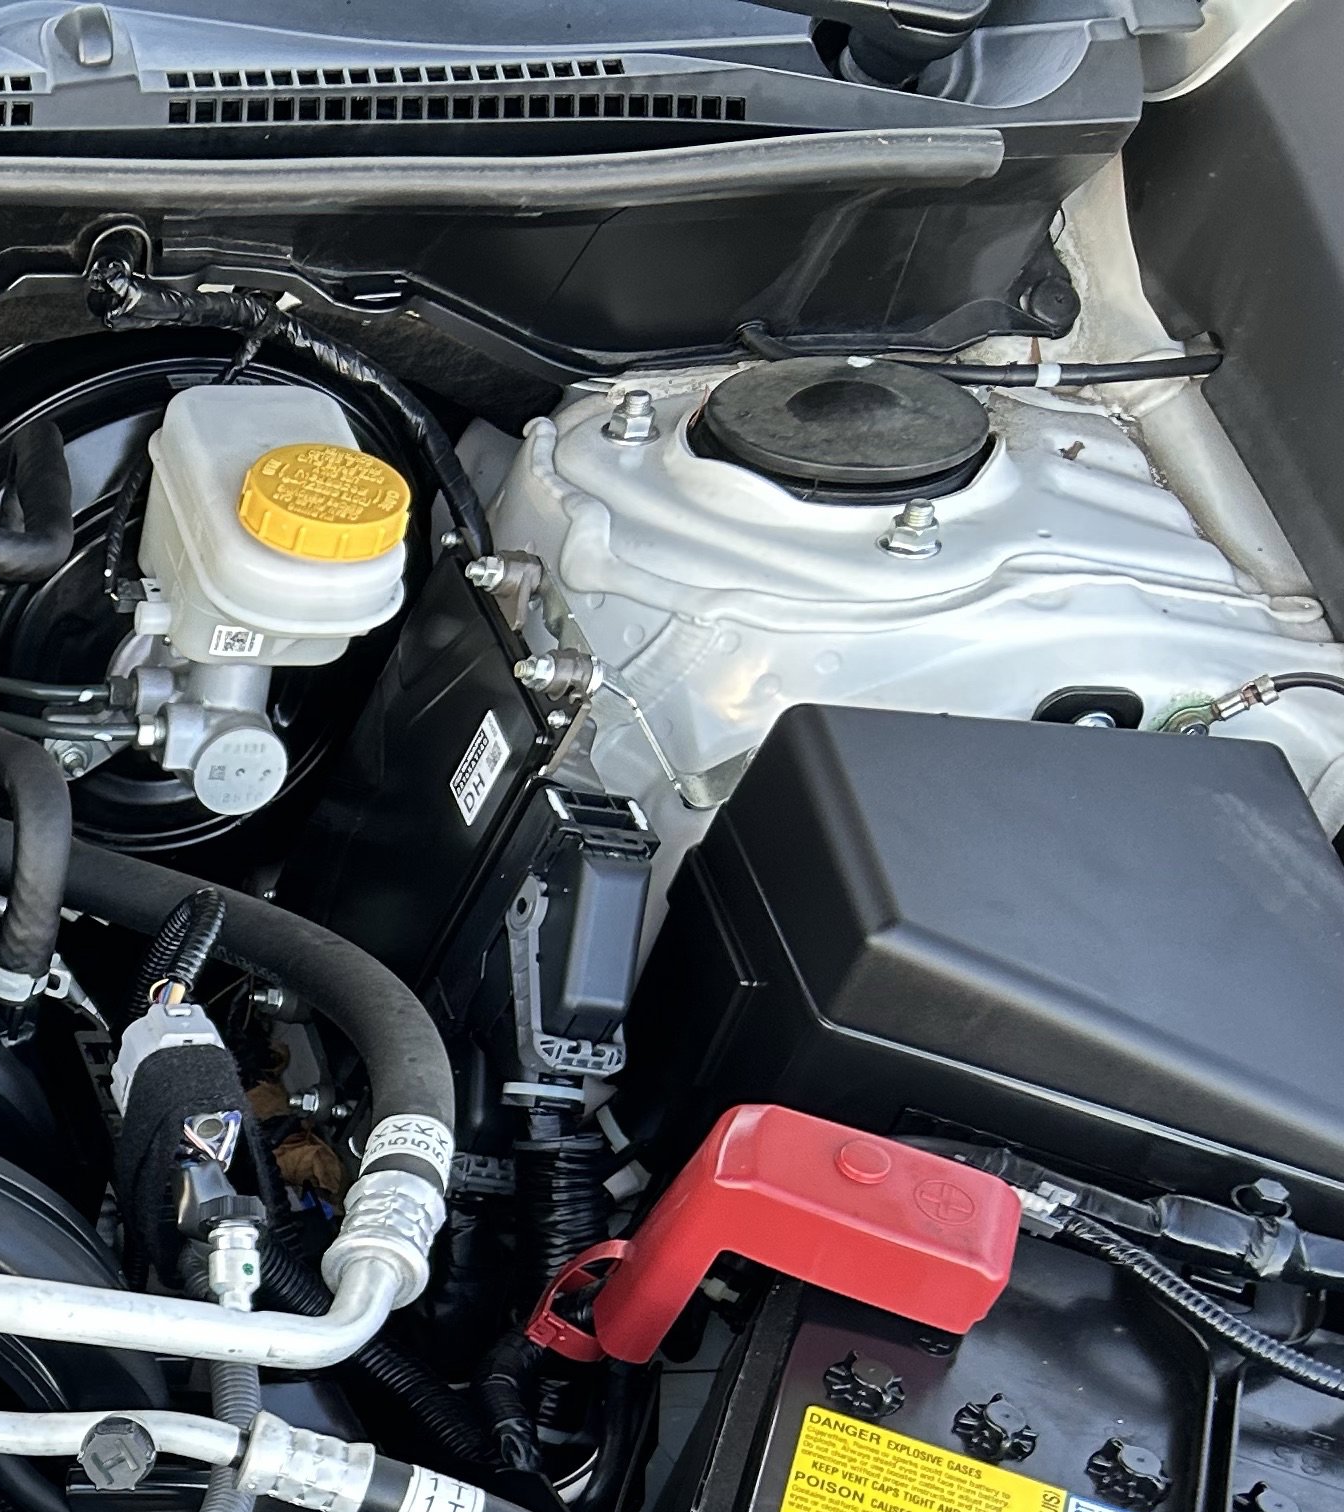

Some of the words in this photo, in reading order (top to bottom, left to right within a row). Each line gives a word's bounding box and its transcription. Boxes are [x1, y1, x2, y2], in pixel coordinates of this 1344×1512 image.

[463, 772, 486, 813] DH
[388, 1122, 413, 1146] 5K
[411, 1123, 434, 1151] 5K
[433, 1132, 448, 1164] 5K
[809, 1412, 881, 1444] DANGER
[886, 1440, 942, 1465] EXPLOSIVE
[946, 1460, 982, 1479] GASES
[794, 1471, 865, 1503] POISON
[811, 1460, 838, 1476] KEEP
[841, 1470, 868, 1486] VENT
[871, 1481, 899, 1497] CAPS
[902, 1491, 934, 1509] TIGHT
